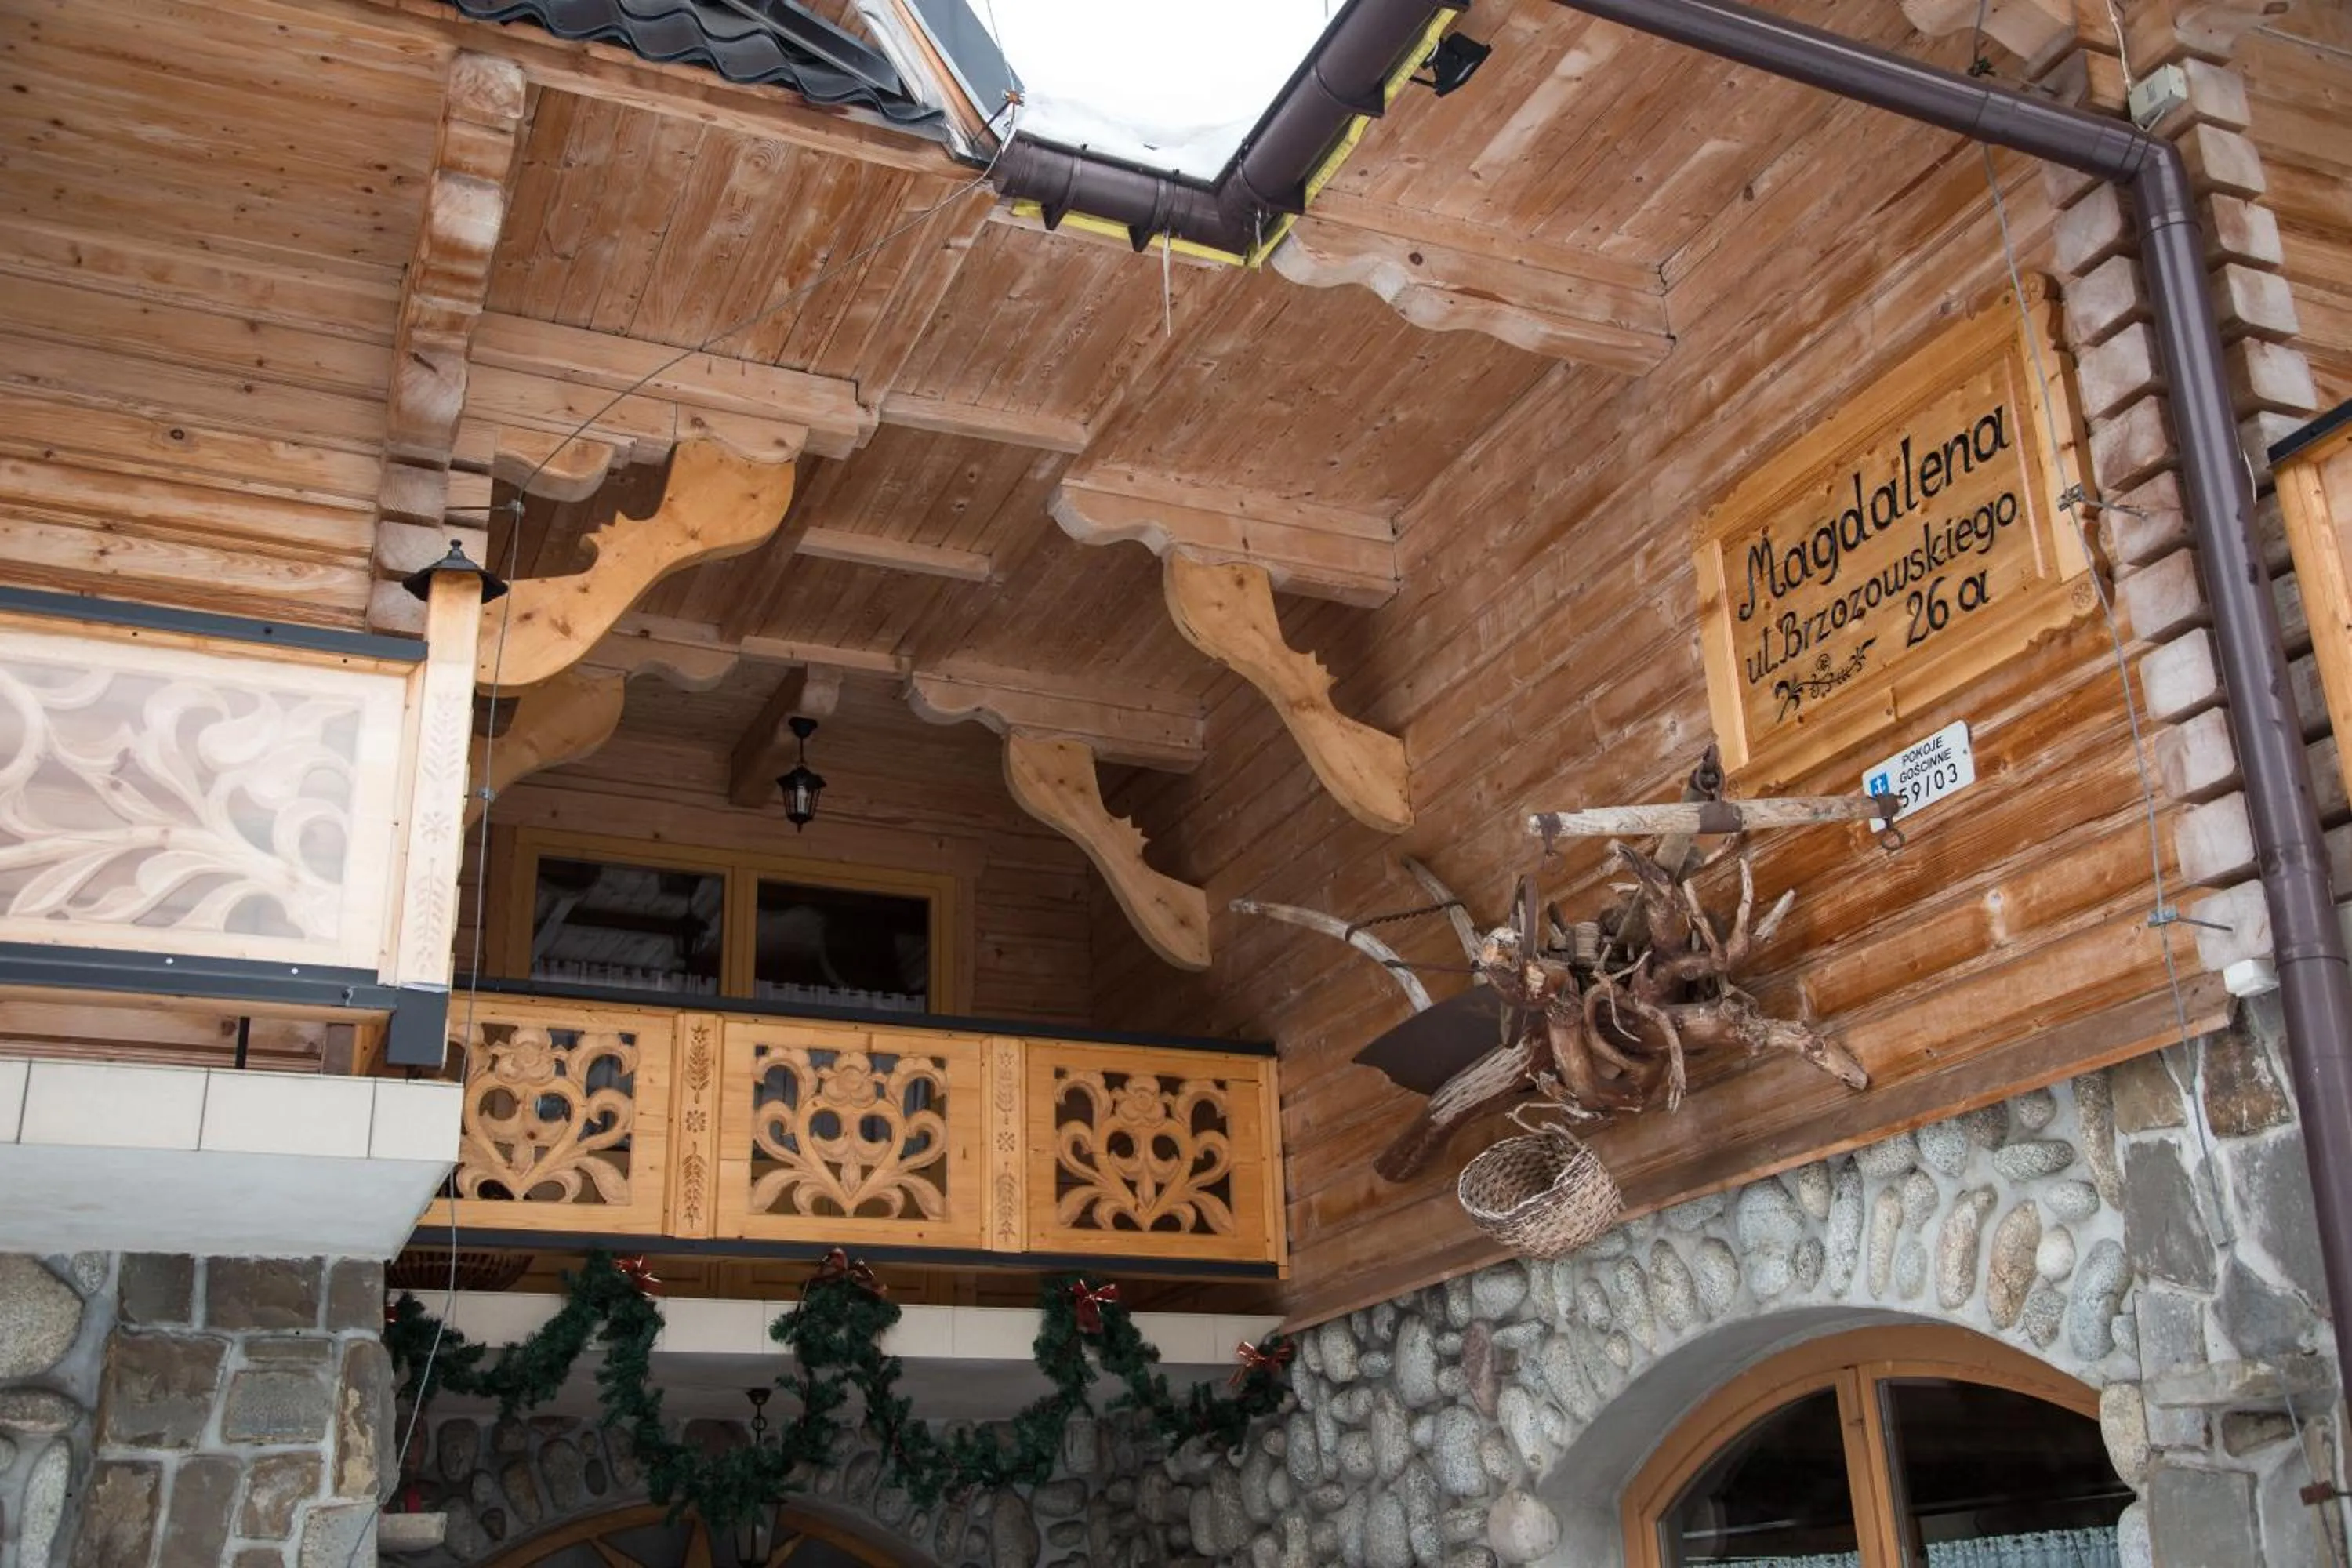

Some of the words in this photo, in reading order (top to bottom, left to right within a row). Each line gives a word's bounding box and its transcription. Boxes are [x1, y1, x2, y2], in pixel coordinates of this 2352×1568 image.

[1739, 405, 2010, 621] Magdalena
[1900, 748, 1951, 783] GOŚCINNE
[1902, 736, 1943, 766] POKOJE
